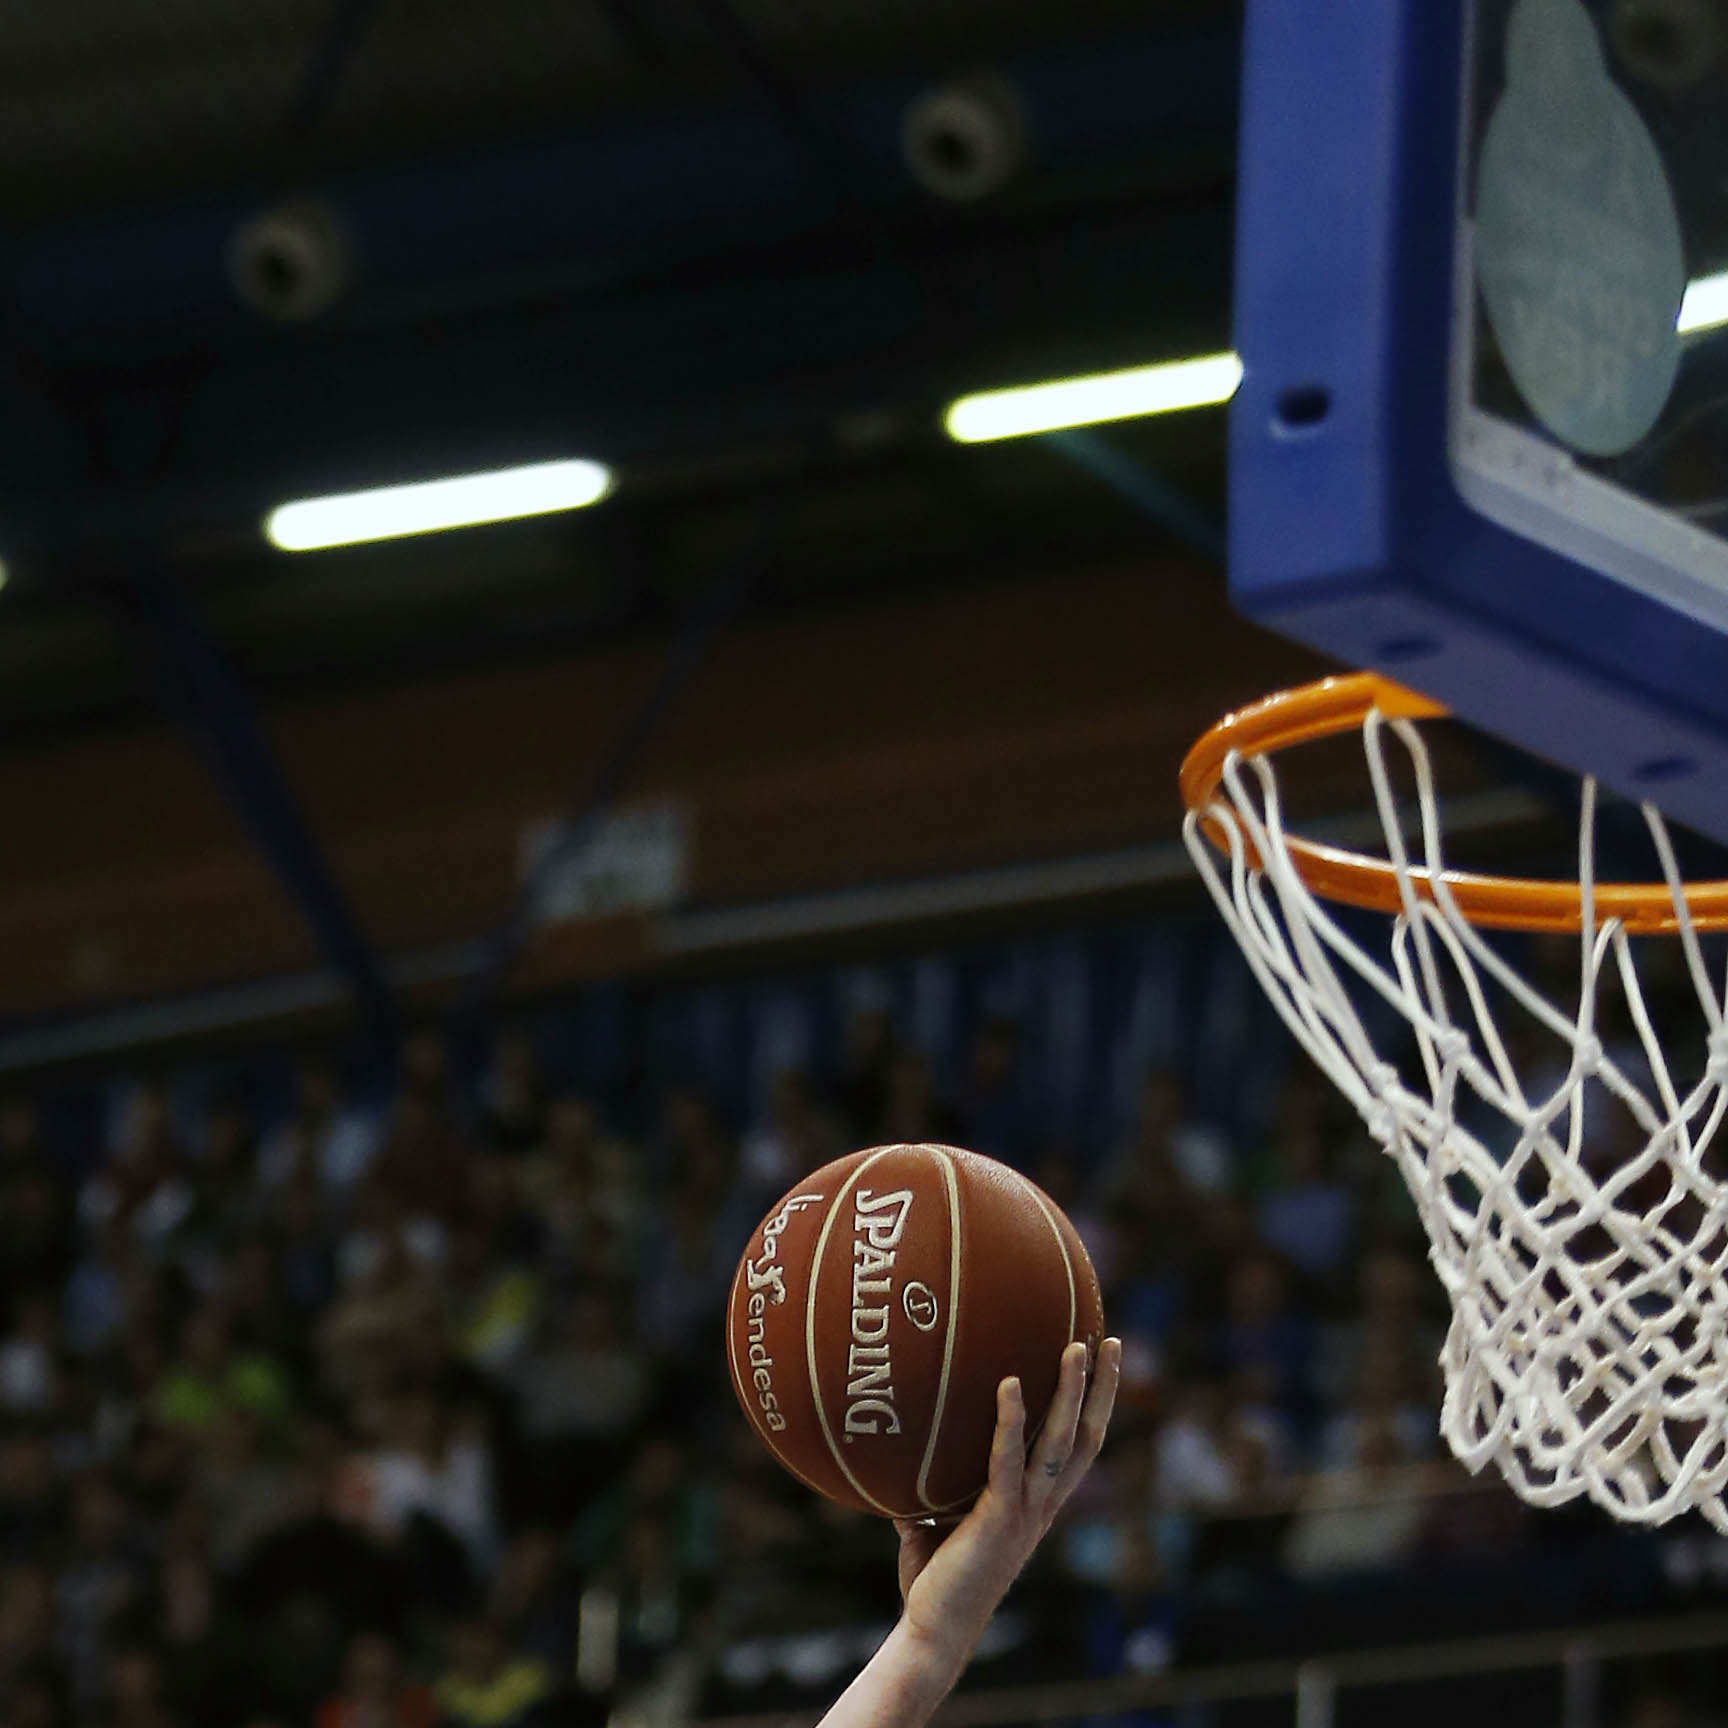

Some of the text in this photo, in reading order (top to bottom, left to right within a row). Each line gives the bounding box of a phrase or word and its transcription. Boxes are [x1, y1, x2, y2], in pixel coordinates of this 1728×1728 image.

[747, 1193, 824, 1432] liga endesa
[844, 1188, 914, 1435] SPALDING
